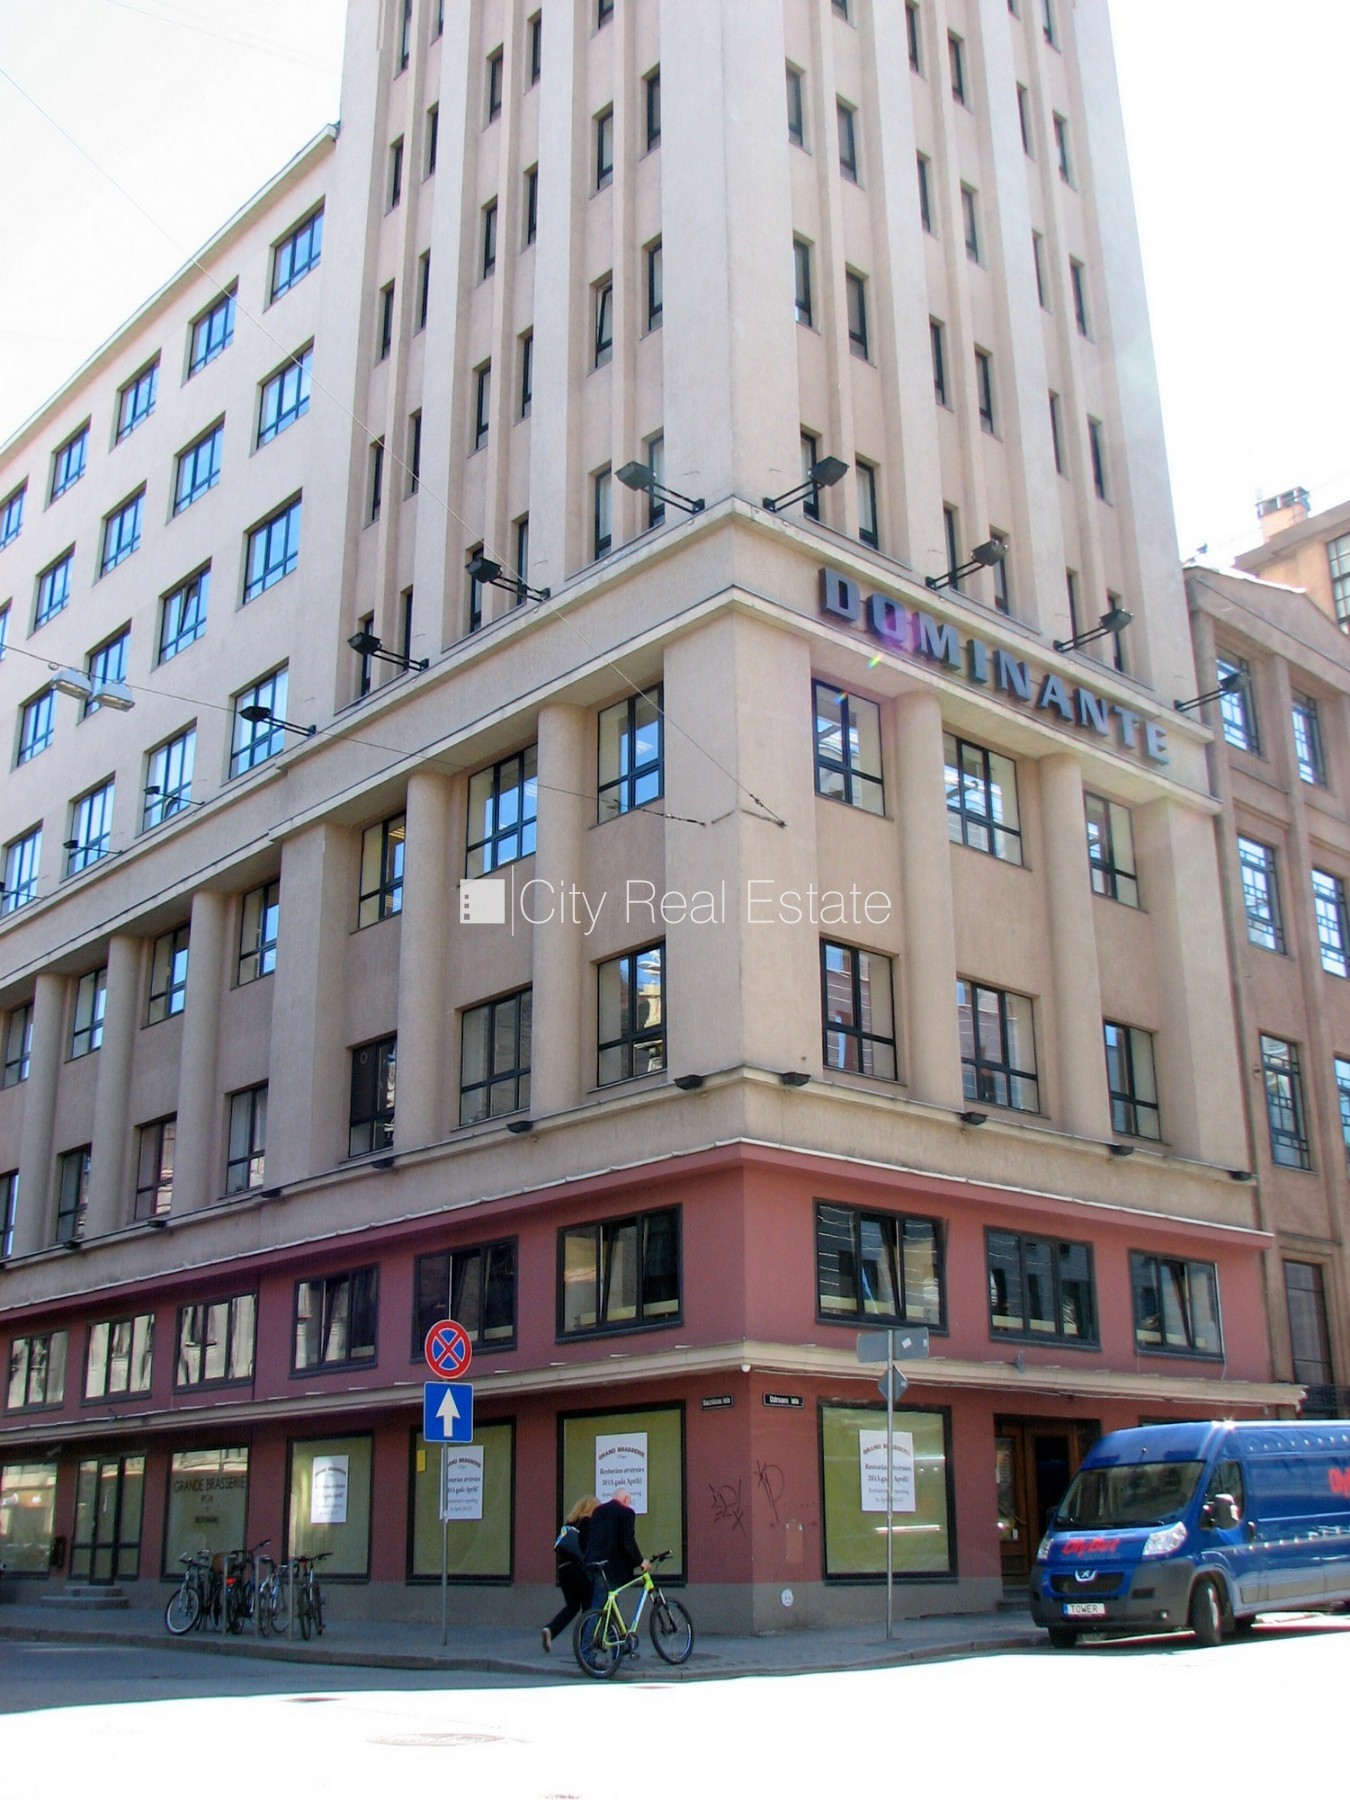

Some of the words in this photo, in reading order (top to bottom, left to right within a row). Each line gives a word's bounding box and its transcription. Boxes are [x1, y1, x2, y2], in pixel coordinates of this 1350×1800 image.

[819, 567, 1169, 765] DOMINANTE
[206, 1476, 246, 1491] BRASSERIE
[1071, 1604, 1098, 1613] TOWER
